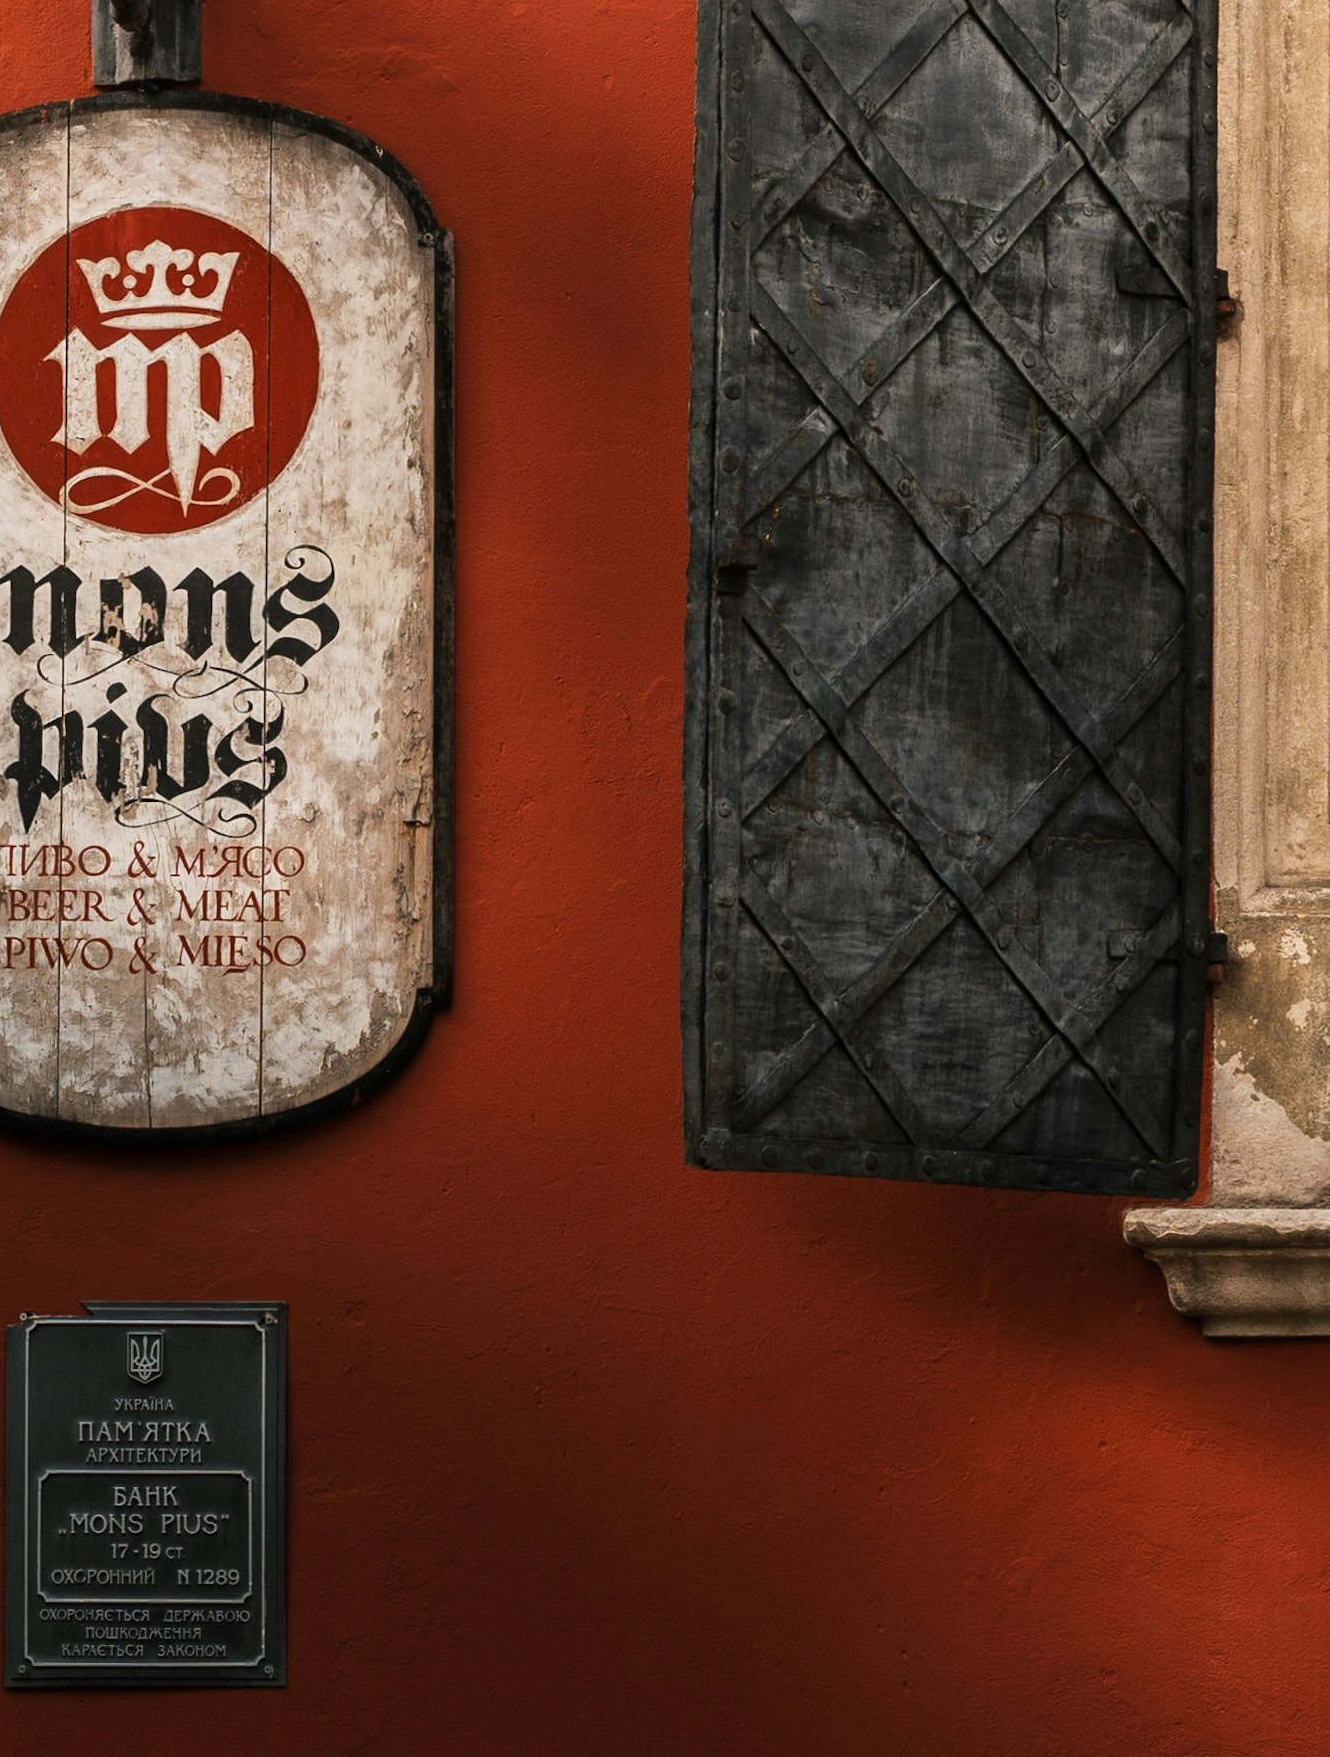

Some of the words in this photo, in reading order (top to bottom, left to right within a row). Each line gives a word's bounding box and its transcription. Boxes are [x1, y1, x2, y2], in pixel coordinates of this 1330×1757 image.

[127, 841, 158, 879] &
[7, 889, 115, 922] BEER
[126, 888, 157, 926] &
[175, 889, 291, 922] MEAT
[2, 936, 114, 970] PIWO
[128, 936, 158, 975] &
[177, 935, 307, 977] MIĘSO
[114, 1397, 175, 1411] УКРАЇНА
[85, 1448, 202, 1464] АРХІТЕКТУРИ
[112, 1486, 179, 1507] БАНК
[51, 1568, 156, 1586] ОХОРОННИЙ
[196, 1569, 240, 1585] 1289
[39, 1608, 150, 1622] ОХОРОНЯЄТЬСЯ
[163, 1609, 251, 1623] ДЕРЖАВОЮ
[85, 1627, 202, 1641] ПОШКОДЖЕННЯ
[62, 1644, 144, 1658] КАРАЄТЬСЯ
[157, 1644, 227, 1658] ЗАКОНОМ
